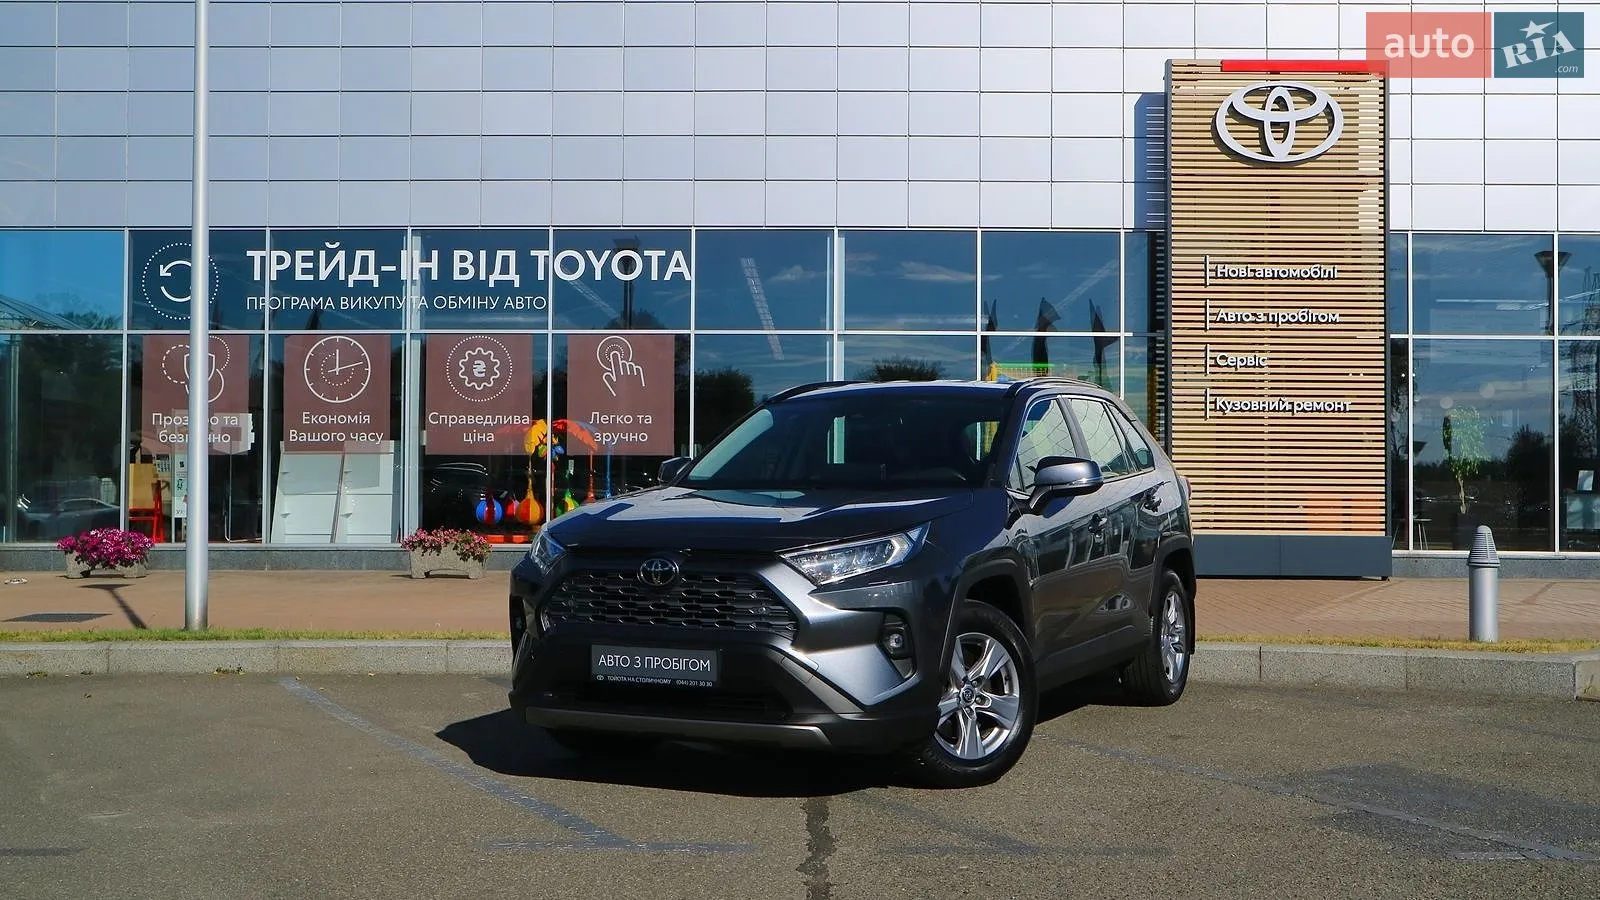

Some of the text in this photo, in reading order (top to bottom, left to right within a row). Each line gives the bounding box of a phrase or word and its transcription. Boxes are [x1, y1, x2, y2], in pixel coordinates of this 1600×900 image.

[246, 241, 438, 287] ТРЕЙД-ІН
[453, 250, 520, 287] ВІД
[1215, 263, 1338, 279] Нові автомобілі
[246, 295, 547, 310] ПРОГРАМА ВИКУПУ ТА ОБМІНУ АВТО
[1215, 308, 1340, 326] Авто з пробігом
[1216, 352, 1268, 370] Сервіс
[1215, 397, 1352, 415] Кузовний ремонт
[152, 412, 239, 429] Прозо та
[302, 411, 371, 424] Економія
[428, 411, 530, 427] Справедлива
[590, 411, 652, 425] Легко та
[289, 429, 384, 444] Вашого часу
[463, 429, 495, 443] ціна
[594, 431, 649, 444] зручно
[598, 654, 711, 671] АВТО З ПРОБІГОМ
